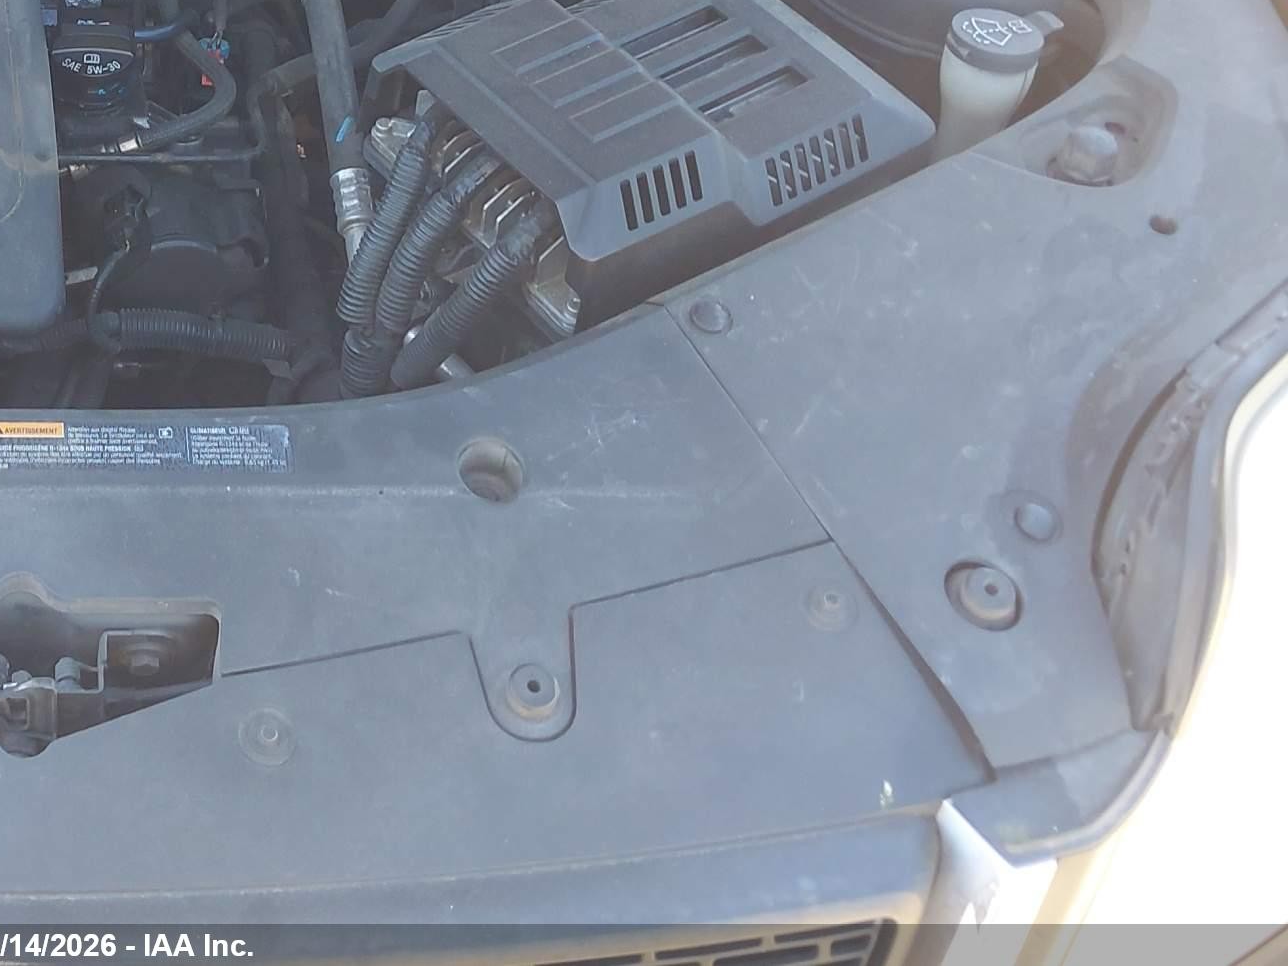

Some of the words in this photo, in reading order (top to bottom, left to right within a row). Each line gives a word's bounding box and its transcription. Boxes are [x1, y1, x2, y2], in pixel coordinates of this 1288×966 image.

[62, 57, 81, 73] SAE
[87, 60, 121, 75] 5W-30
[4, 426, 58, 434] AVERTISSEMENT
